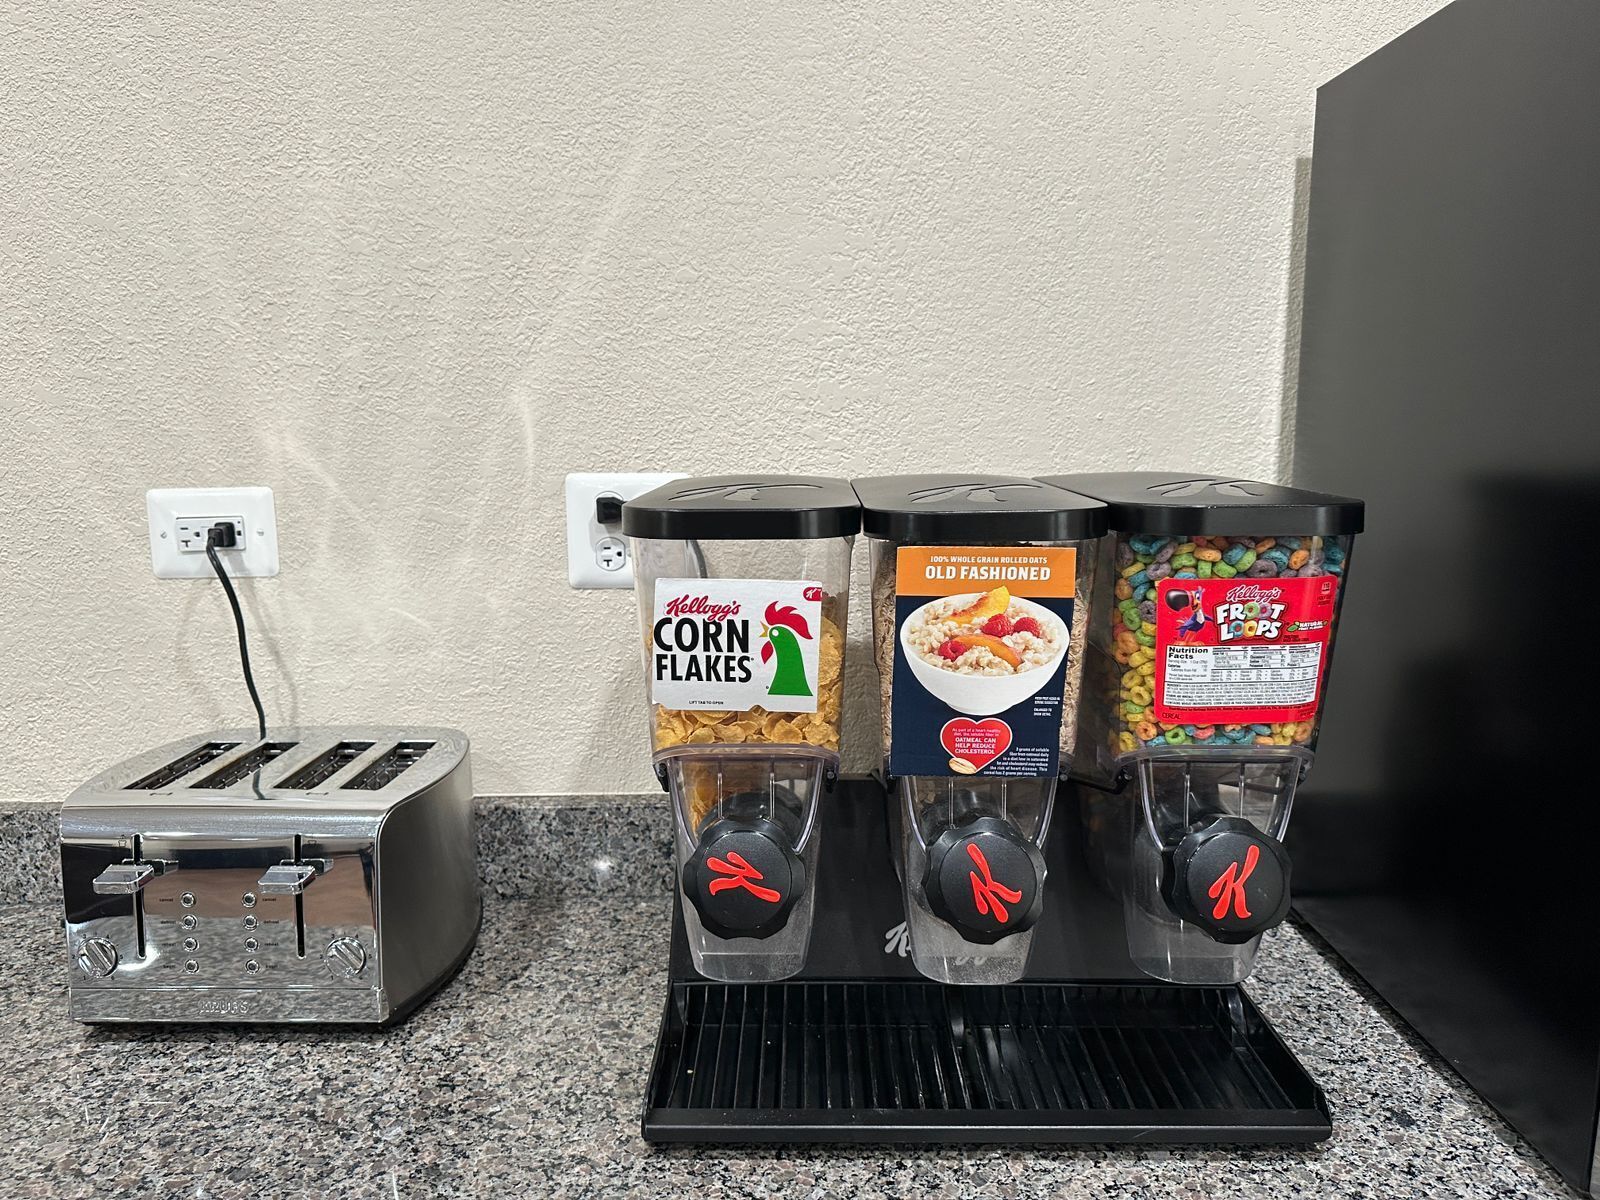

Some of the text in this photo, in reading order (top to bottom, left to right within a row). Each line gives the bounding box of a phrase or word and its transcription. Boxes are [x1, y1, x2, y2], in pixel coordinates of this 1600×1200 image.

[925, 565, 1051, 581] OLD FASHIONED
[666, 594, 741, 621] Kellogg's
[1226, 585, 1280, 602] Kellogg's
[1216, 602, 1286, 625] FROOT
[653, 617, 749, 653] CORN
[1220, 620, 1283, 641] LOOPS
[656, 654, 752, 683] FLAKES
[707, 851, 781, 902] K
[966, 843, 1023, 923] K
[1209, 845, 1259, 919] K
